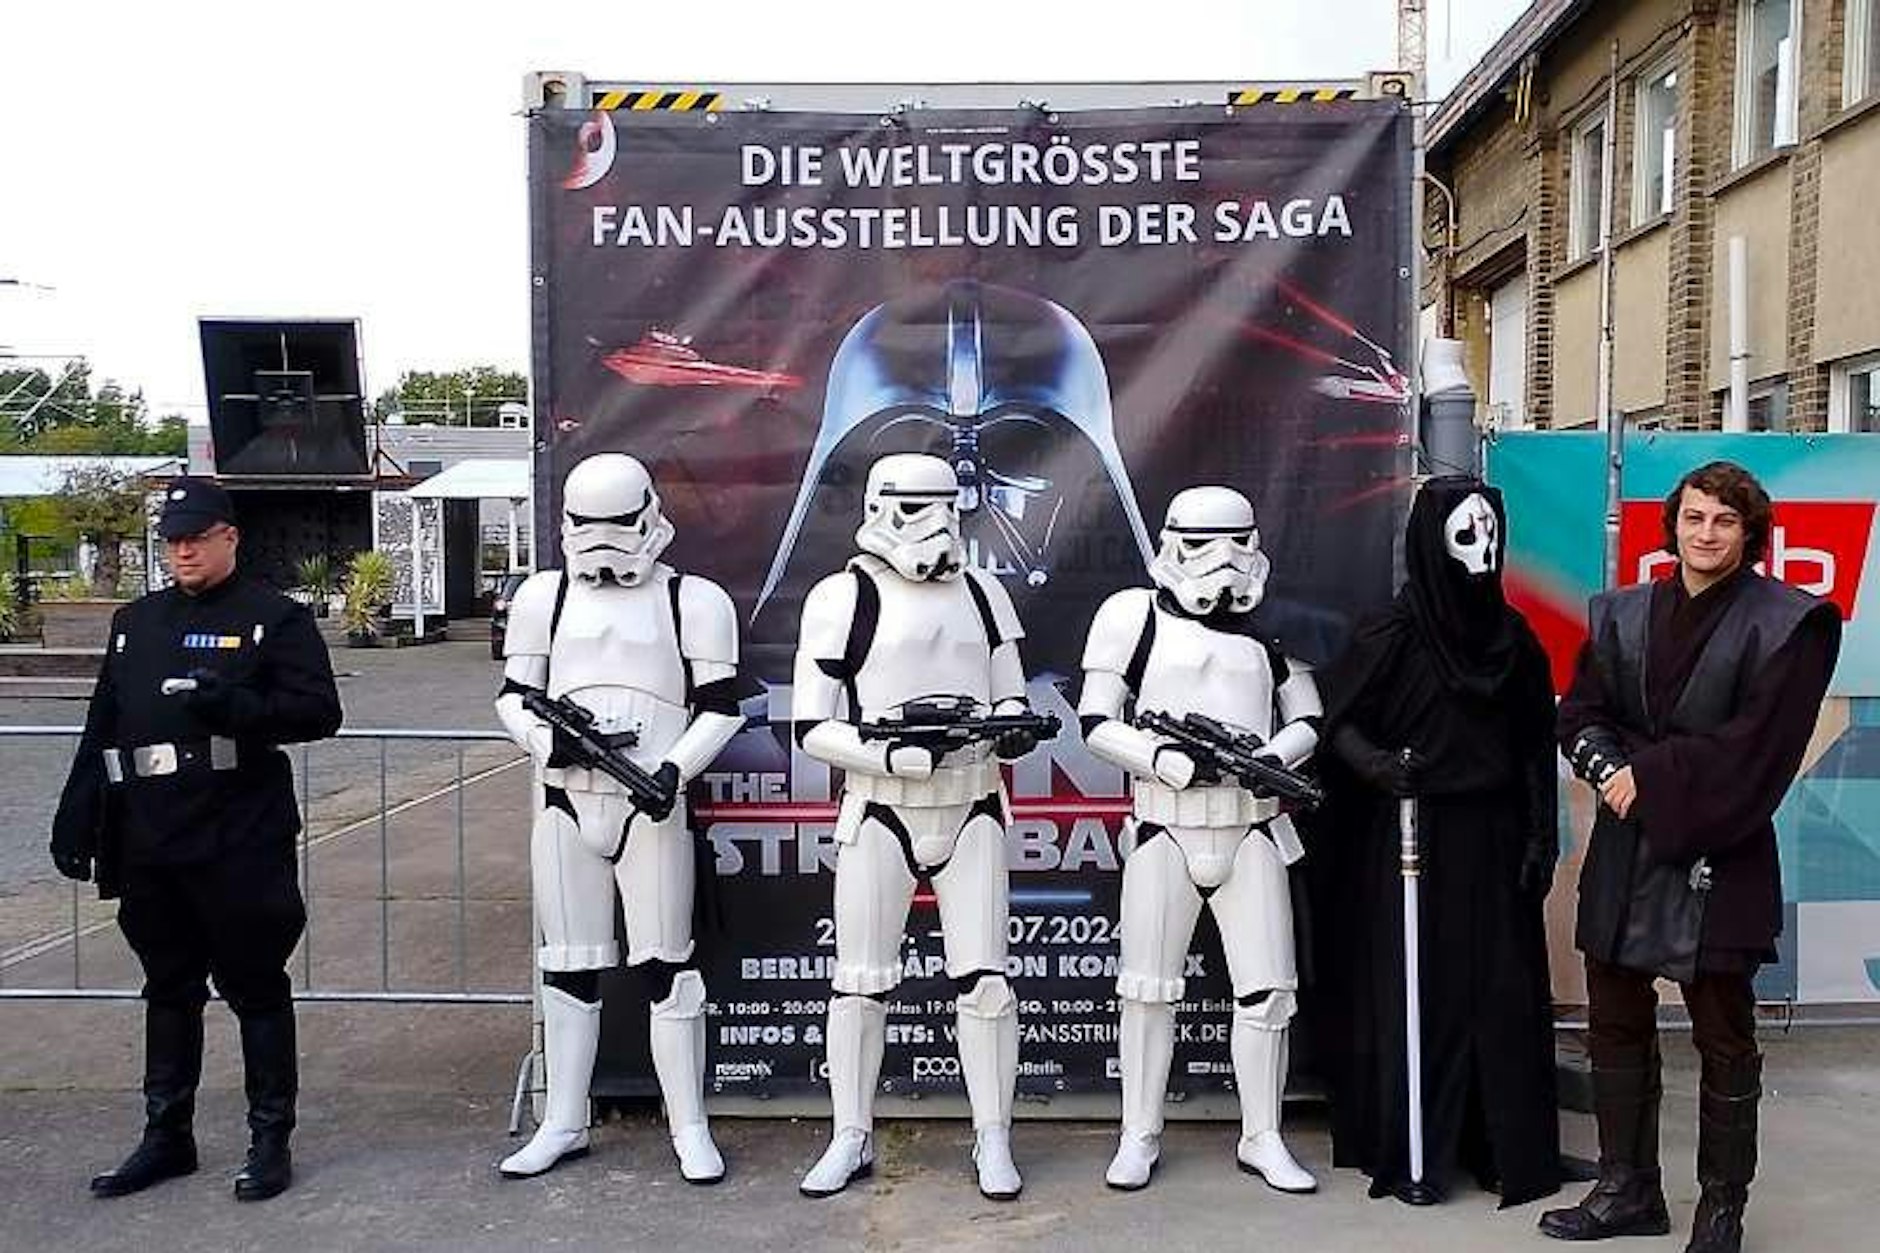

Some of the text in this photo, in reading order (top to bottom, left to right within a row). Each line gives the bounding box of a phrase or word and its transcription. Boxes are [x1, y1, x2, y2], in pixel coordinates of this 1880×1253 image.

[741, 134, 1201, 189] DIE WELTGRÖSSTE
[592, 194, 1353, 249] FAN-AUSSTELLUNG DER SAGA
[702, 772, 789, 803] THE
[727, 1001, 770, 1015] 10:00
[781, 1000, 826, 1015] 20:00
[1051, 1000, 1094, 1014] 10:00
[720, 1025, 796, 1045] INFOS
[803, 1024, 824, 1045] &
[885, 1024, 935, 1043] ETS:
